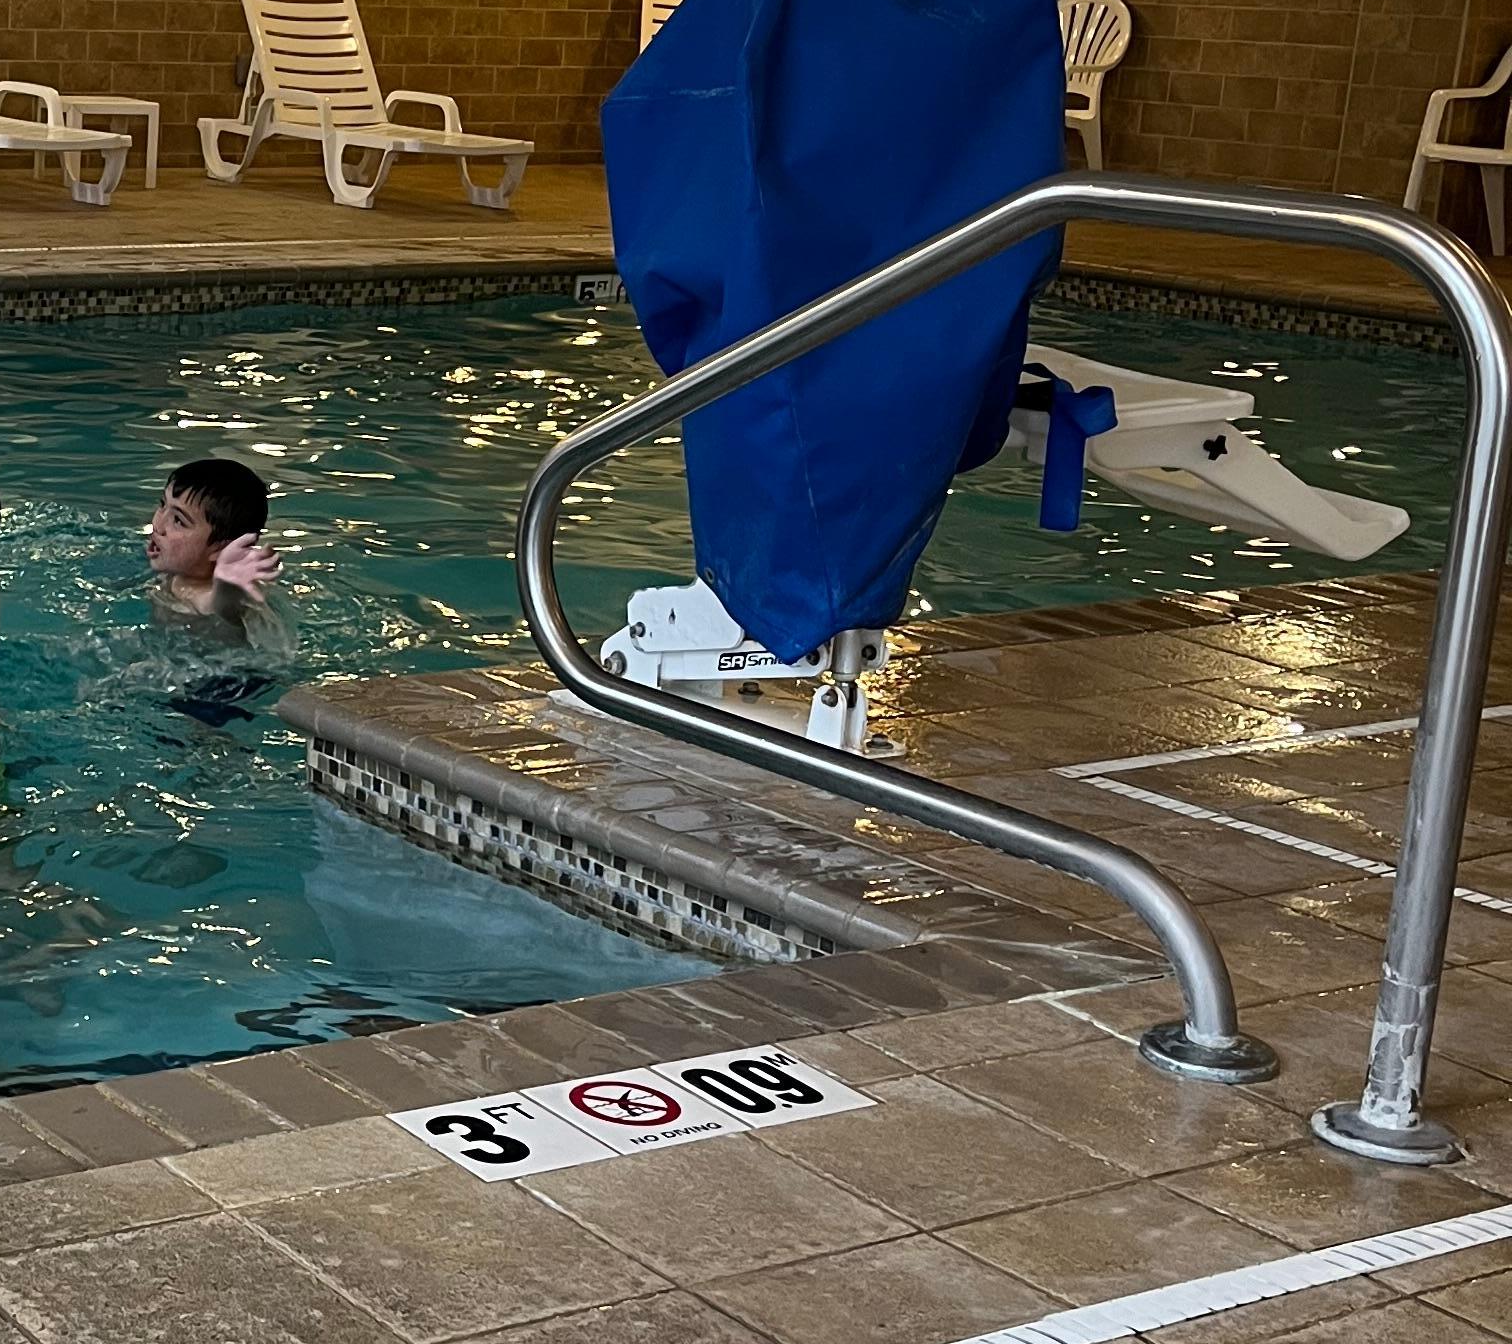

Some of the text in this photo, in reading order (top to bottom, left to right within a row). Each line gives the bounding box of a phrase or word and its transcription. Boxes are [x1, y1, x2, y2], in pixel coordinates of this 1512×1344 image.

[719, 655, 745, 669] SR
[425, 1114, 531, 1164] 3
[481, 1102, 536, 1125] FT
[770, 1052, 799, 1068] M
[629, 1122, 722, 1145] NO DIVING
